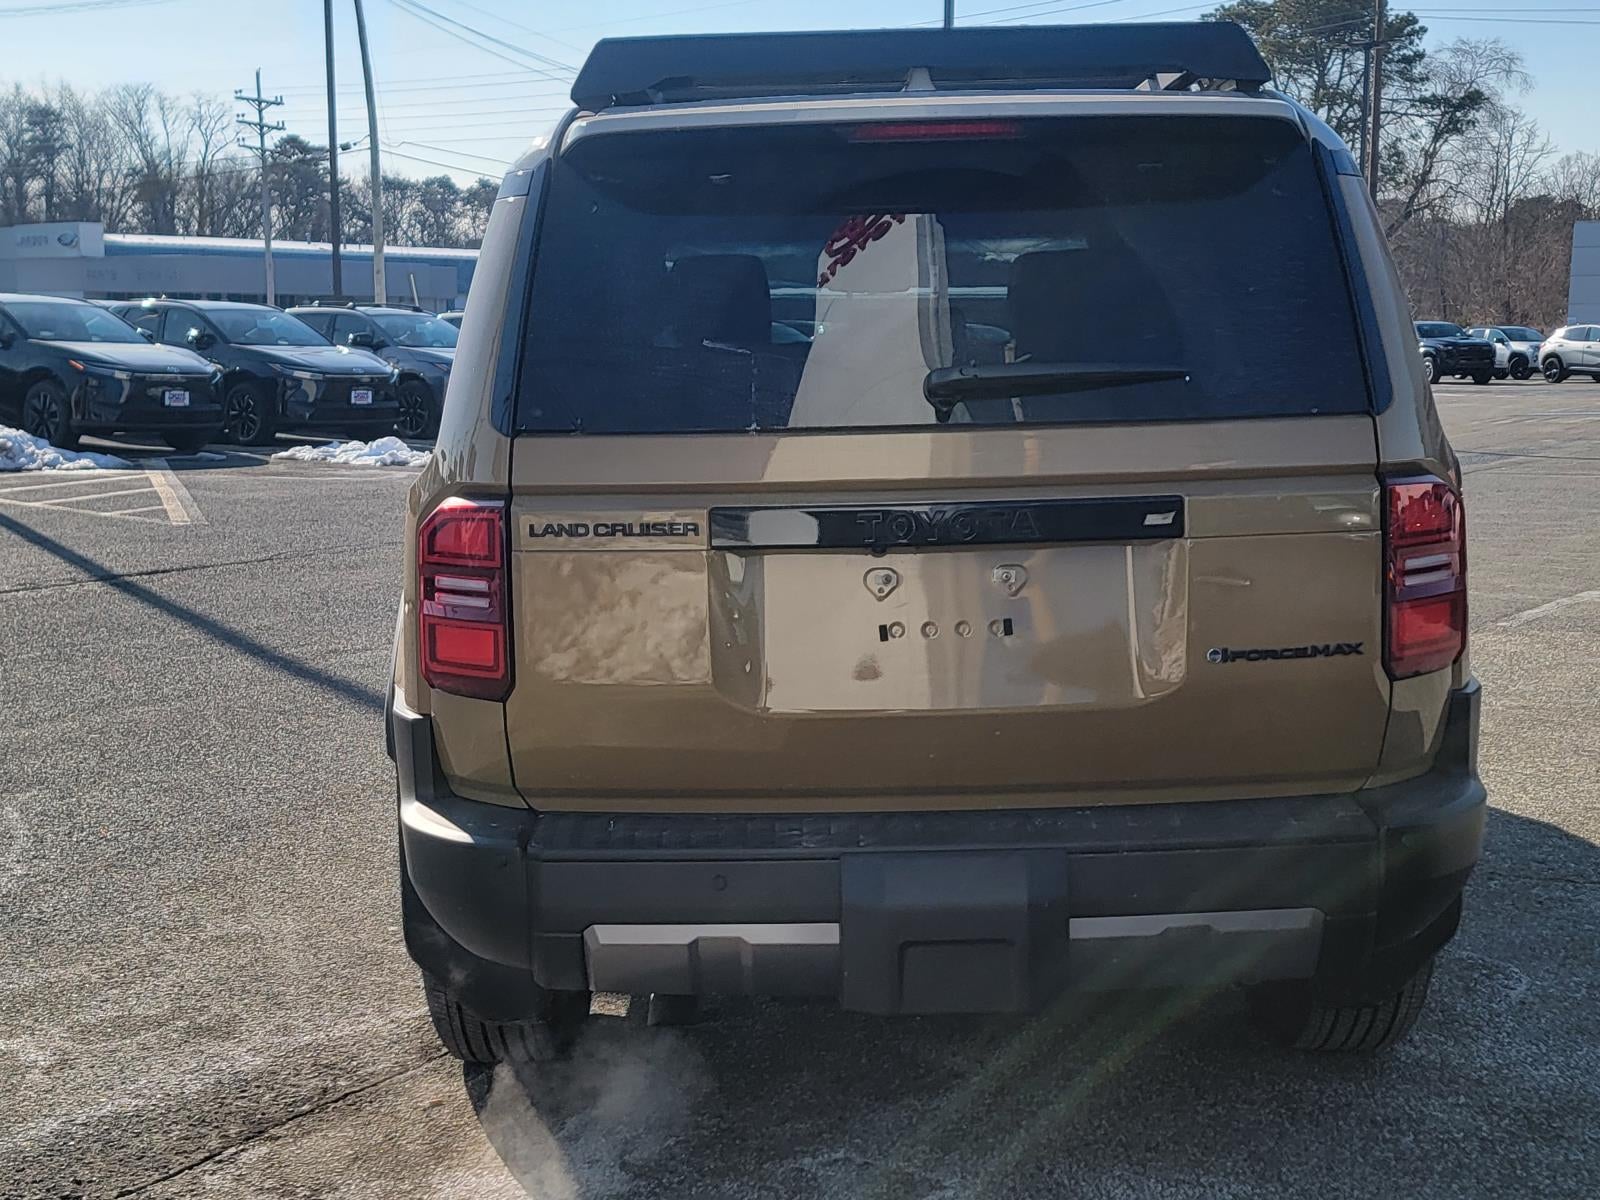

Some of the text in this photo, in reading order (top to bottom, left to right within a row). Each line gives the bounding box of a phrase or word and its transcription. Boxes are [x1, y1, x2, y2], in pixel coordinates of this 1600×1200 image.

[529, 522, 700, 538] LAND CRUISER
[856, 509, 1041, 543] TOYOTA
[1310, 642, 1364, 657] MAX
